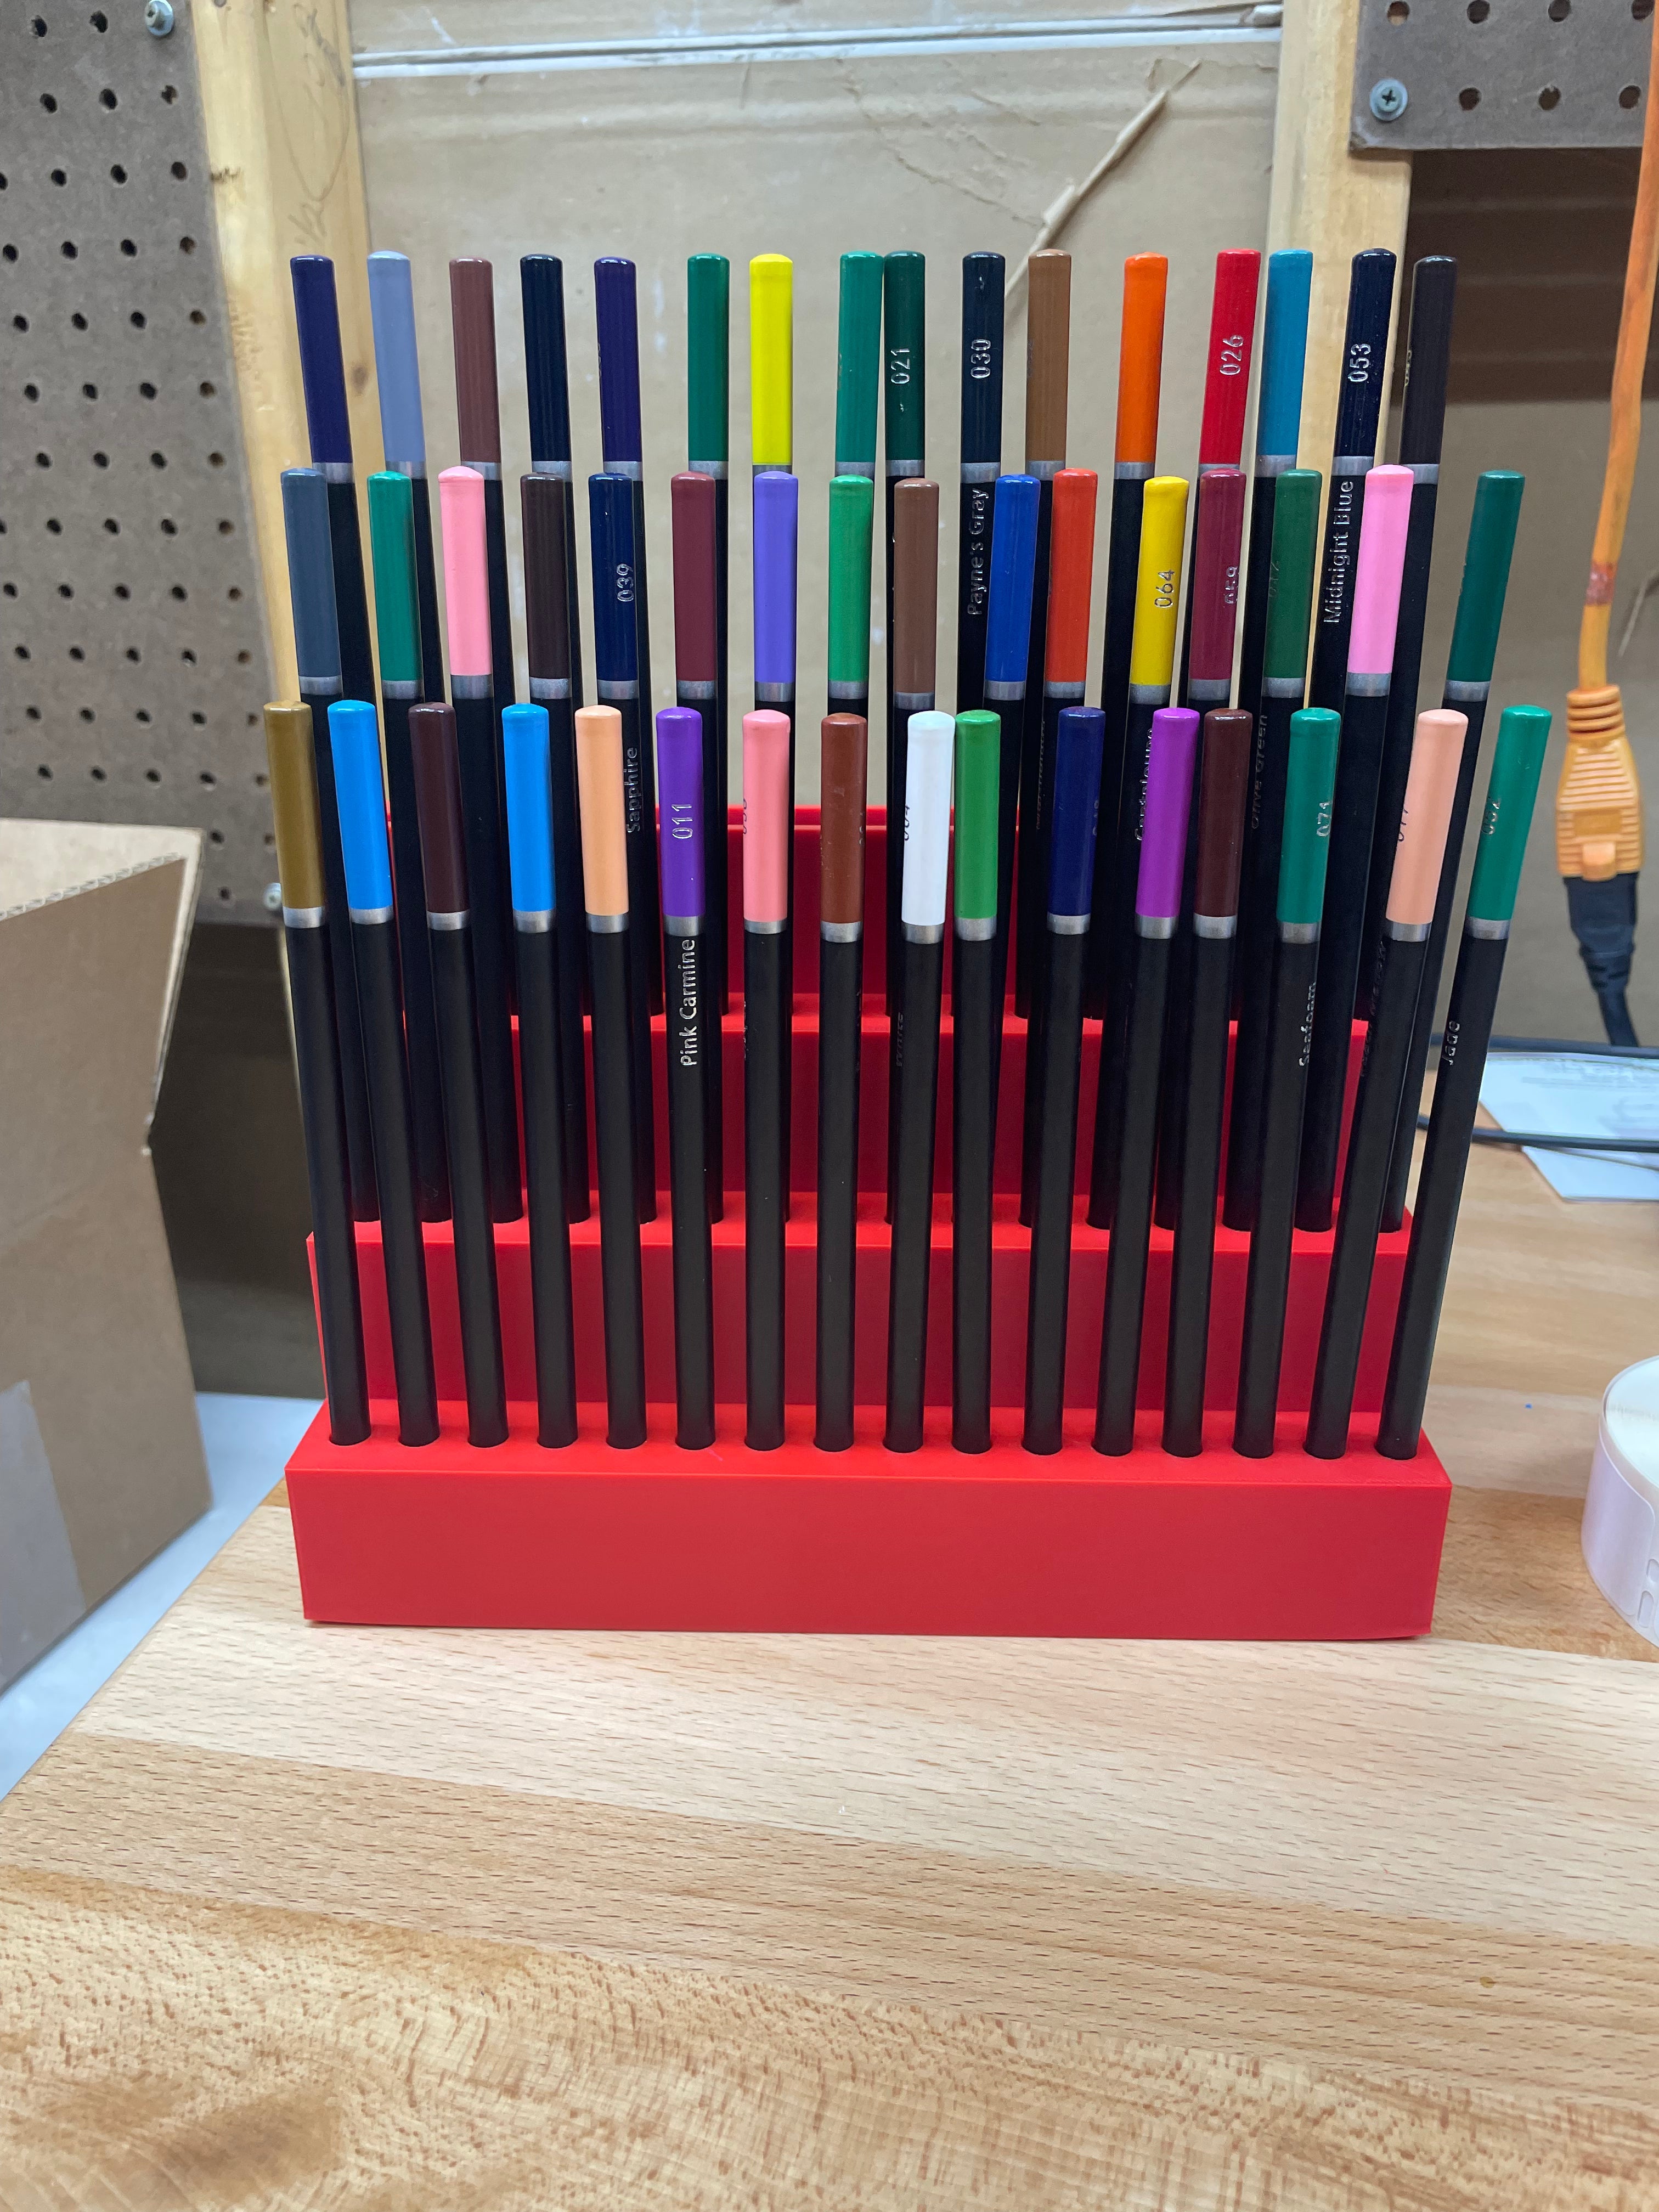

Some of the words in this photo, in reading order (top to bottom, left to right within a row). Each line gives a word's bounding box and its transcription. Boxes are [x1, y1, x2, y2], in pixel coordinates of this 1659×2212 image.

[891, 347, 910, 384] 021
[970, 338, 991, 379] 030
[1219, 334, 1244, 376] 026
[1347, 343, 1371, 382] 053
[968, 488, 989, 535] Gray
[1333, 481, 1354, 526] Blue
[616, 563, 634, 602] 039
[967, 540, 986, 617] Payne's
[1154, 569, 1175, 608] 064
[1323, 530, 1351, 623] Midnight
[623, 747, 641, 833] Sapphire
[671, 803, 693, 839] 011
[1316, 800, 1332, 837] 071
[678, 939, 697, 1020] Carmine
[680, 1026, 697, 1066] Pink
